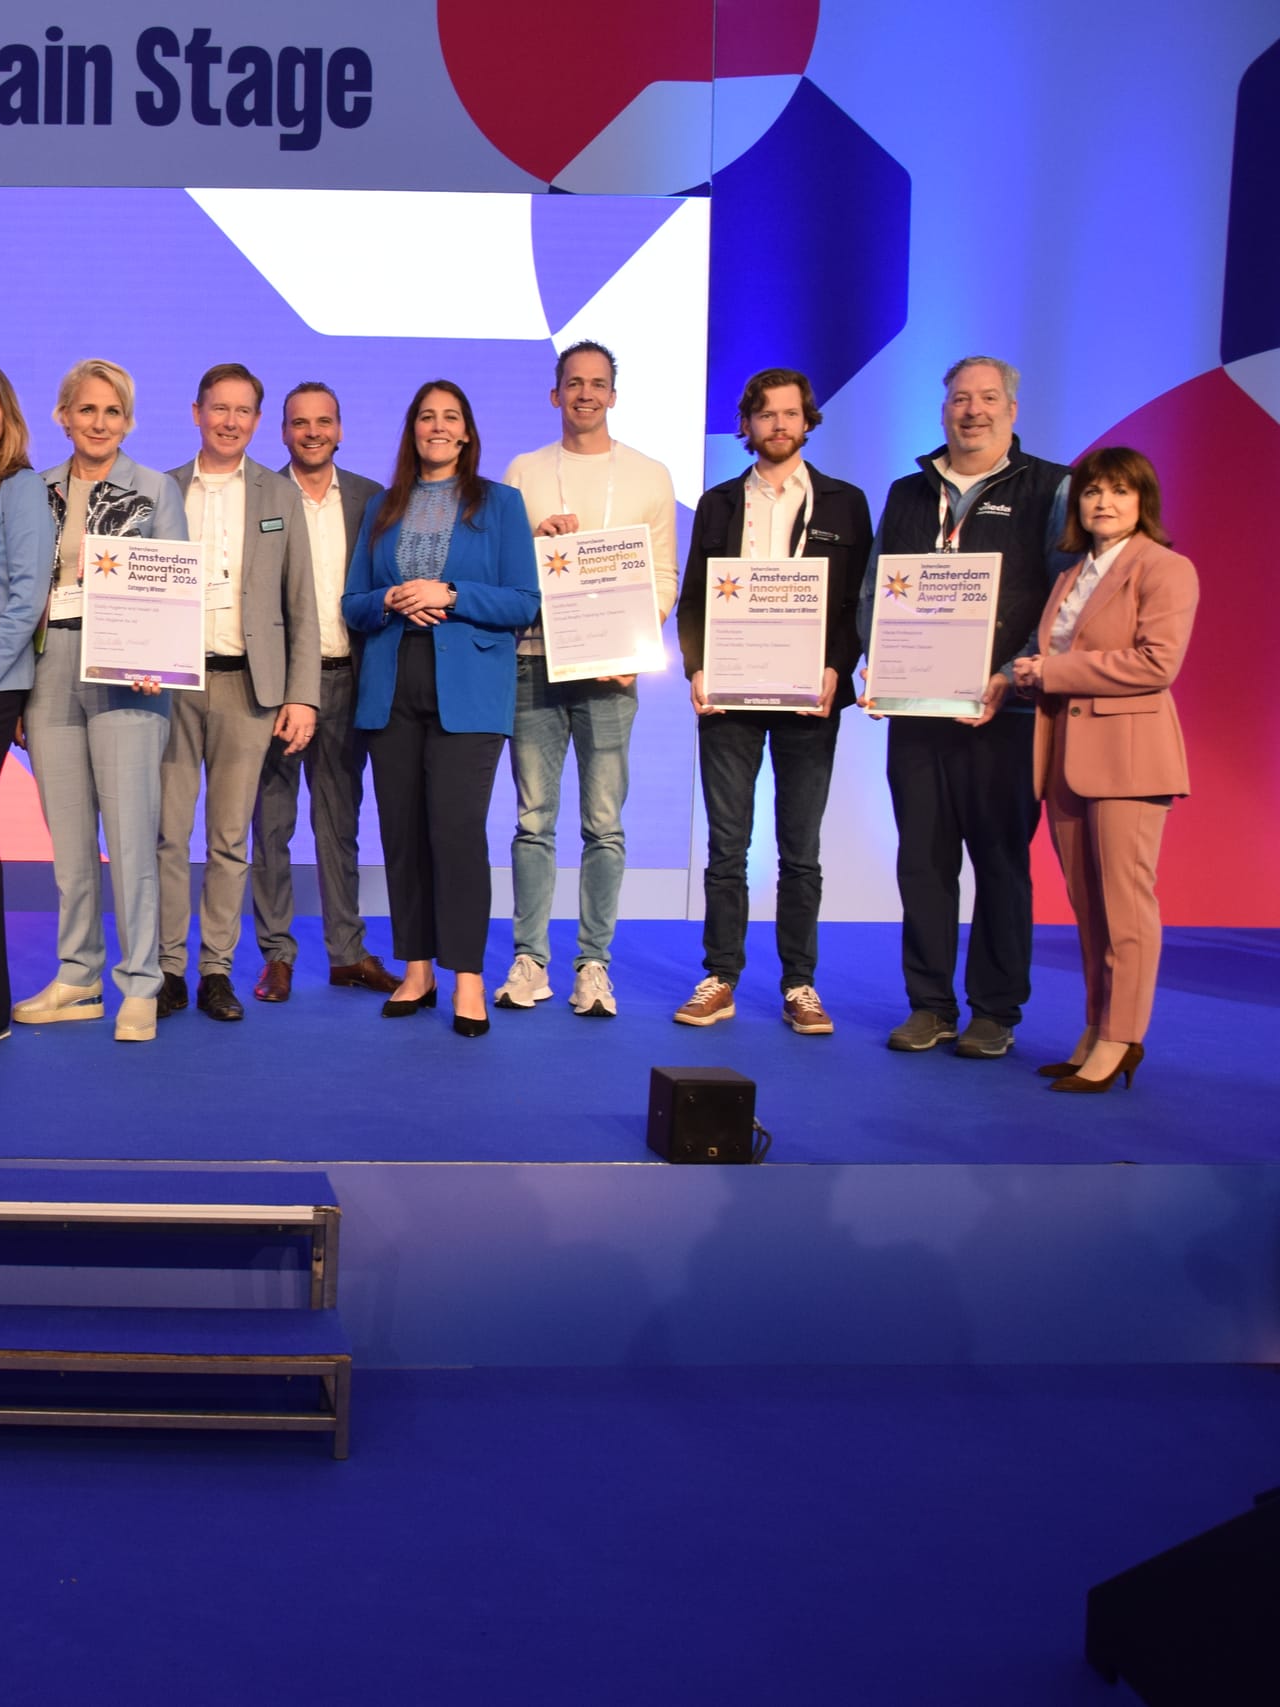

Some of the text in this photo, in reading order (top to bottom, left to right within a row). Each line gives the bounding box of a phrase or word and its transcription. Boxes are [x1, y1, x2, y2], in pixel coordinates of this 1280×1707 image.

[135, 26, 373, 151] Stage
[578, 541, 643, 555] Amsterdam
[129, 552, 198, 565] Amsterdam
[578, 551, 637, 565] Innovation
[128, 562, 190, 574] Innovation
[579, 560, 646, 575] Award 2026
[128, 572, 197, 584] Award 2026
[750, 572, 819, 582] Amsterdam
[920, 569, 990, 580] Amsterdam
[750, 583, 811, 592] Innovation
[919, 580, 981, 591] Innovation
[749, 593, 818, 602] Award 2026
[918, 592, 987, 602] Award 2026
